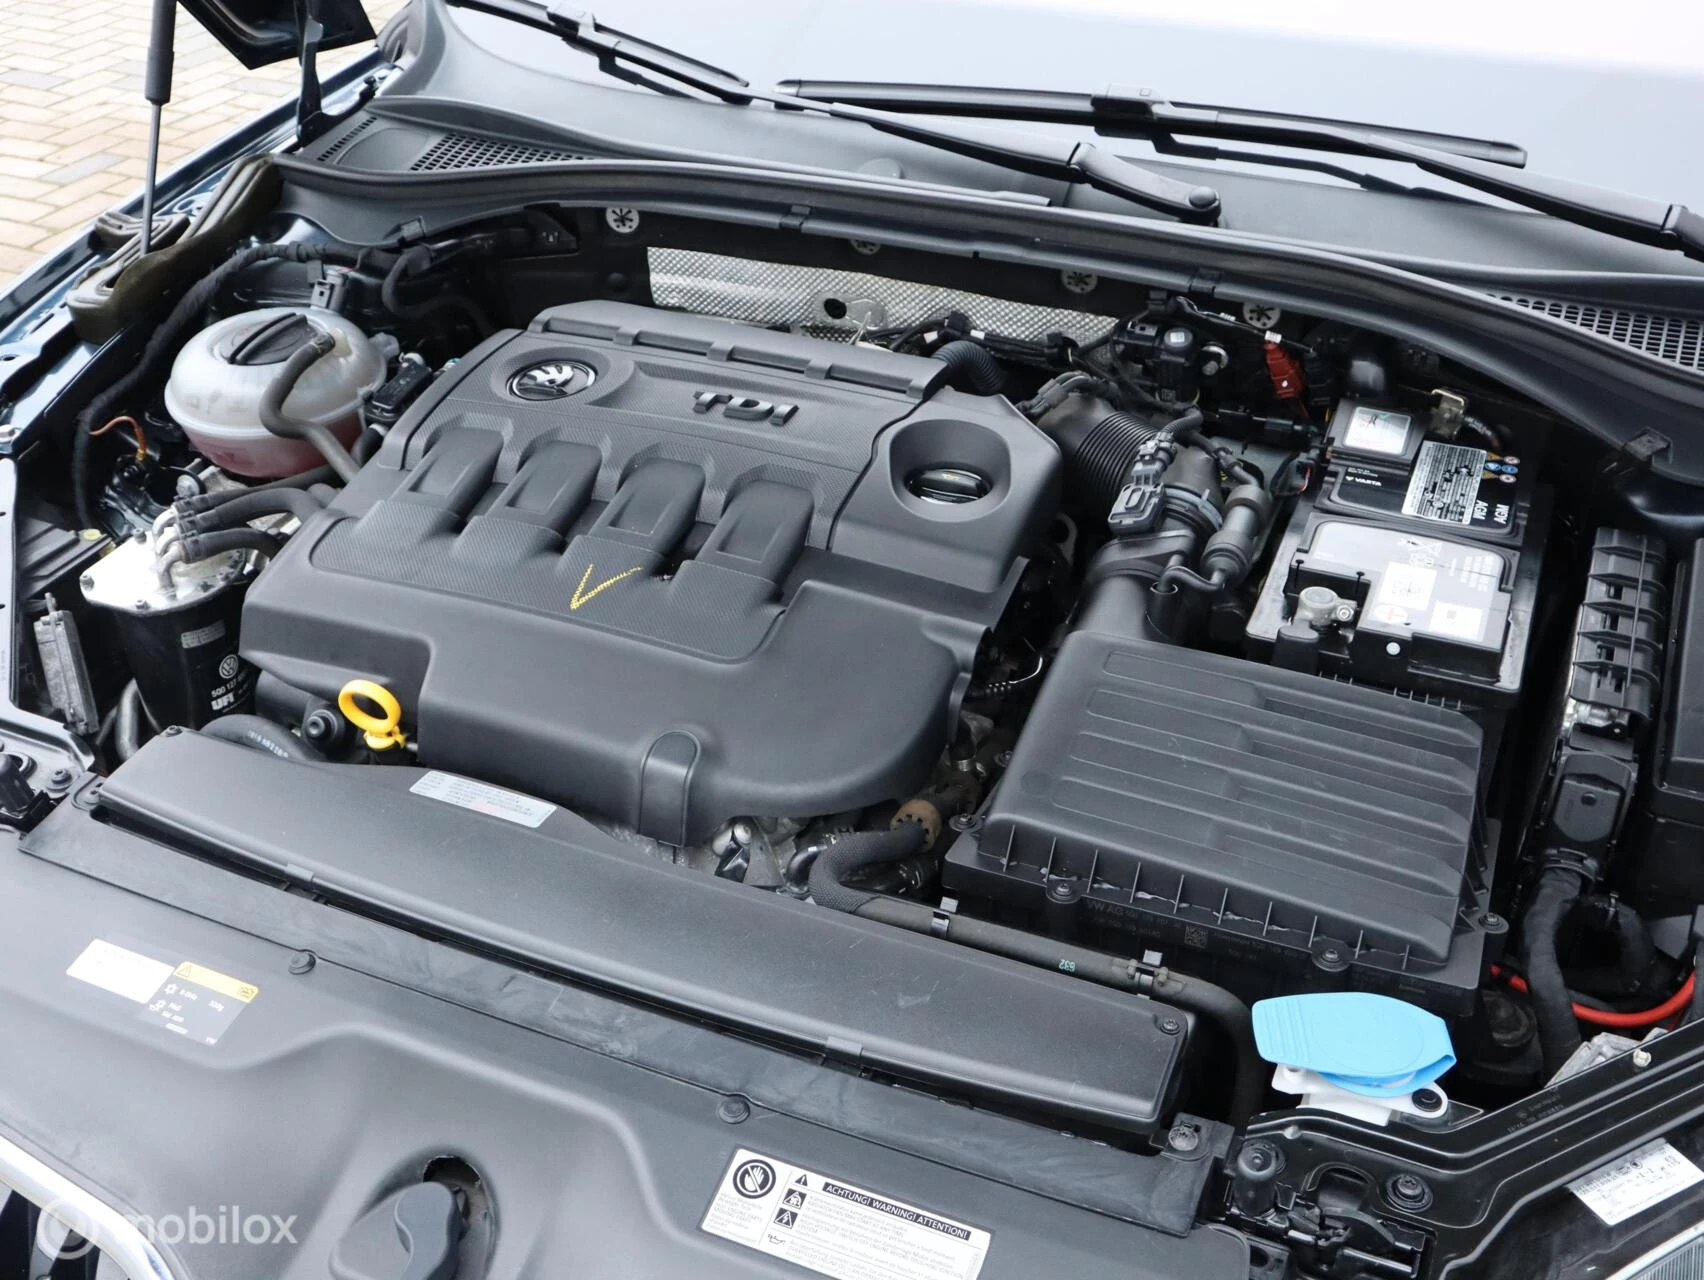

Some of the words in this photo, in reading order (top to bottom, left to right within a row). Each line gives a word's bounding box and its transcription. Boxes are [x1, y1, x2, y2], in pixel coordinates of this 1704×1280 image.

[693, 391, 799, 426] TDI
[1355, 476, 1382, 487] VARTA
[1473, 499, 1488, 520] AGM
[1493, 503, 1510, 525] AGM
[211, 692, 235, 711] UFI
[1058, 958, 1076, 972] 632
[825, 1184, 872, 1206] ACHTUNG!
[872, 1197, 917, 1221] WARNING!
[916, 1214, 969, 1239] ATTENTION!
